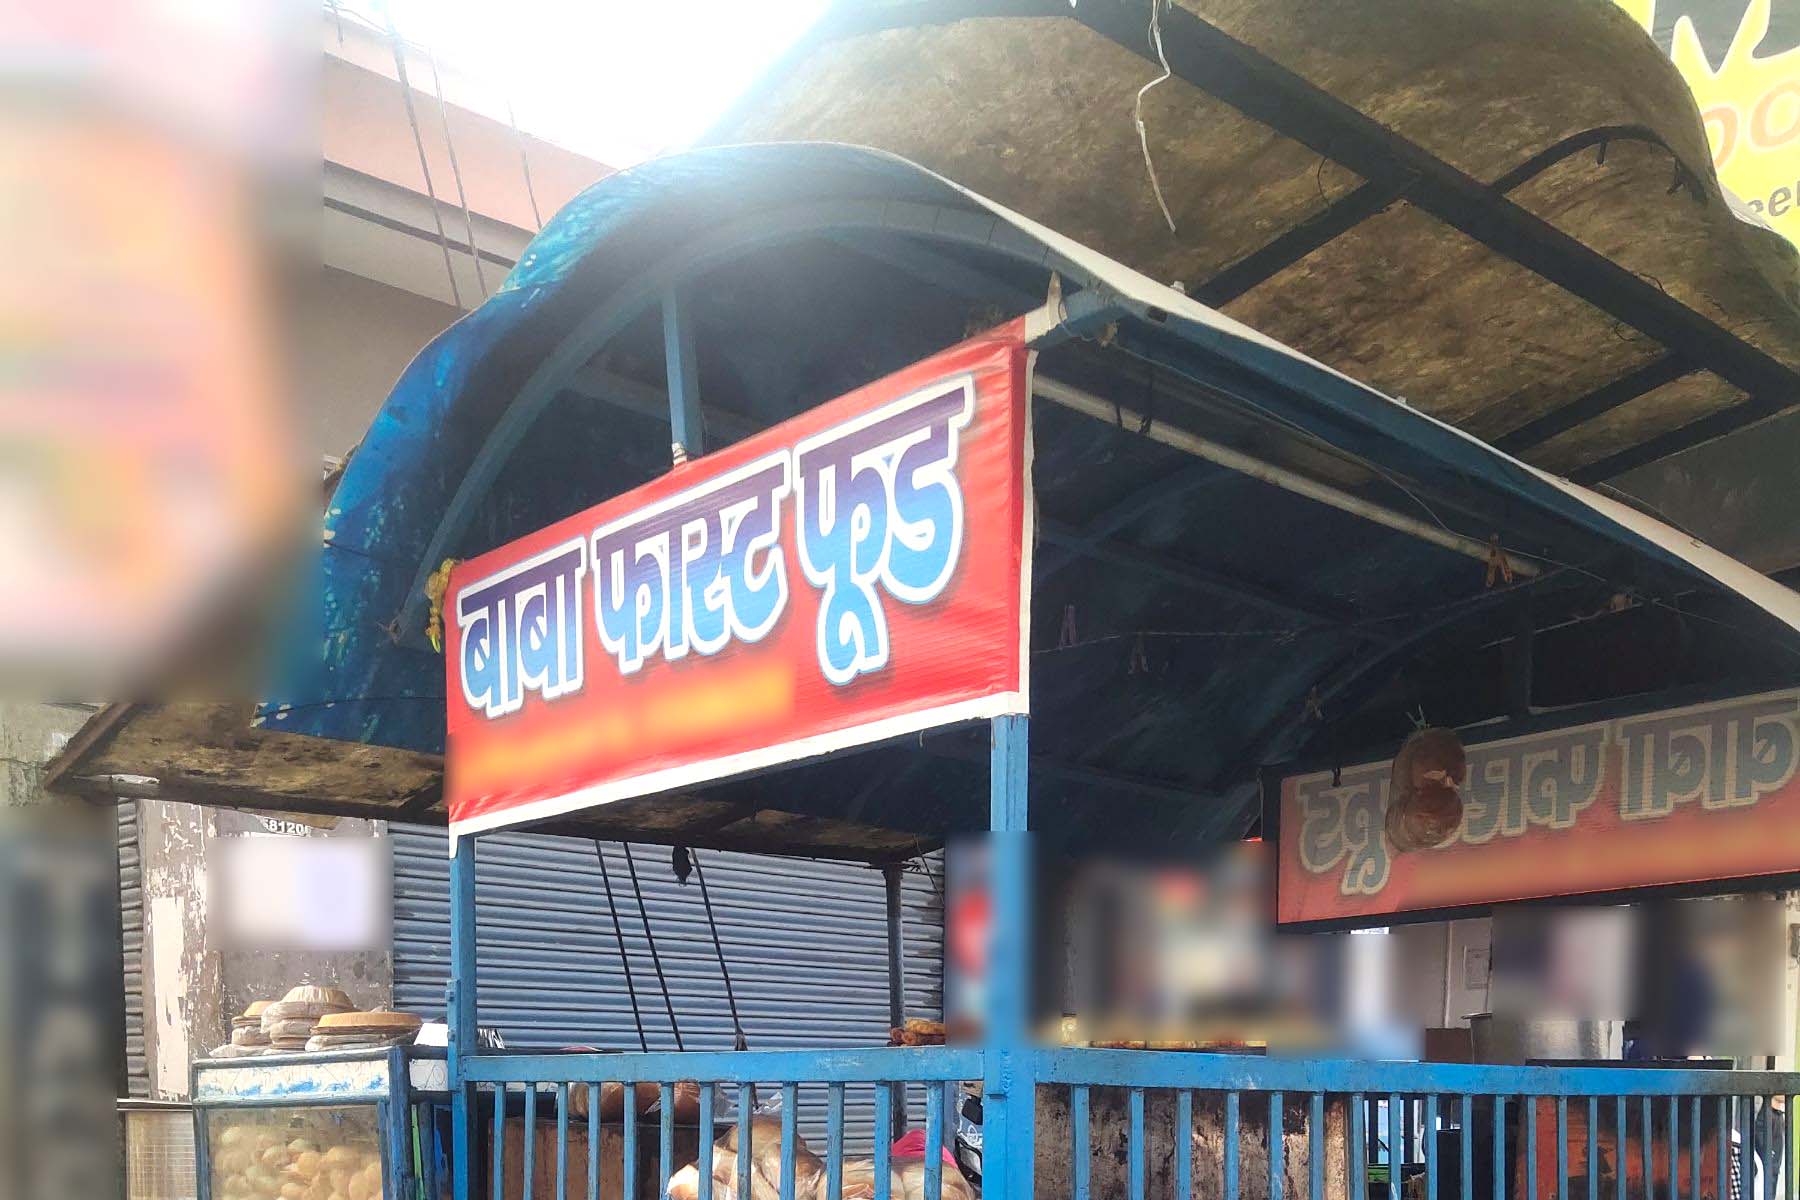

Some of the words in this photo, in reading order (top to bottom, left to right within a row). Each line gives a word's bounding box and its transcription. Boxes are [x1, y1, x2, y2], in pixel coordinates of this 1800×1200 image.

[456, 536, 588, 720] बाबा
[591, 448, 793, 675] फास्ट
[793, 374, 975, 687] फूड
